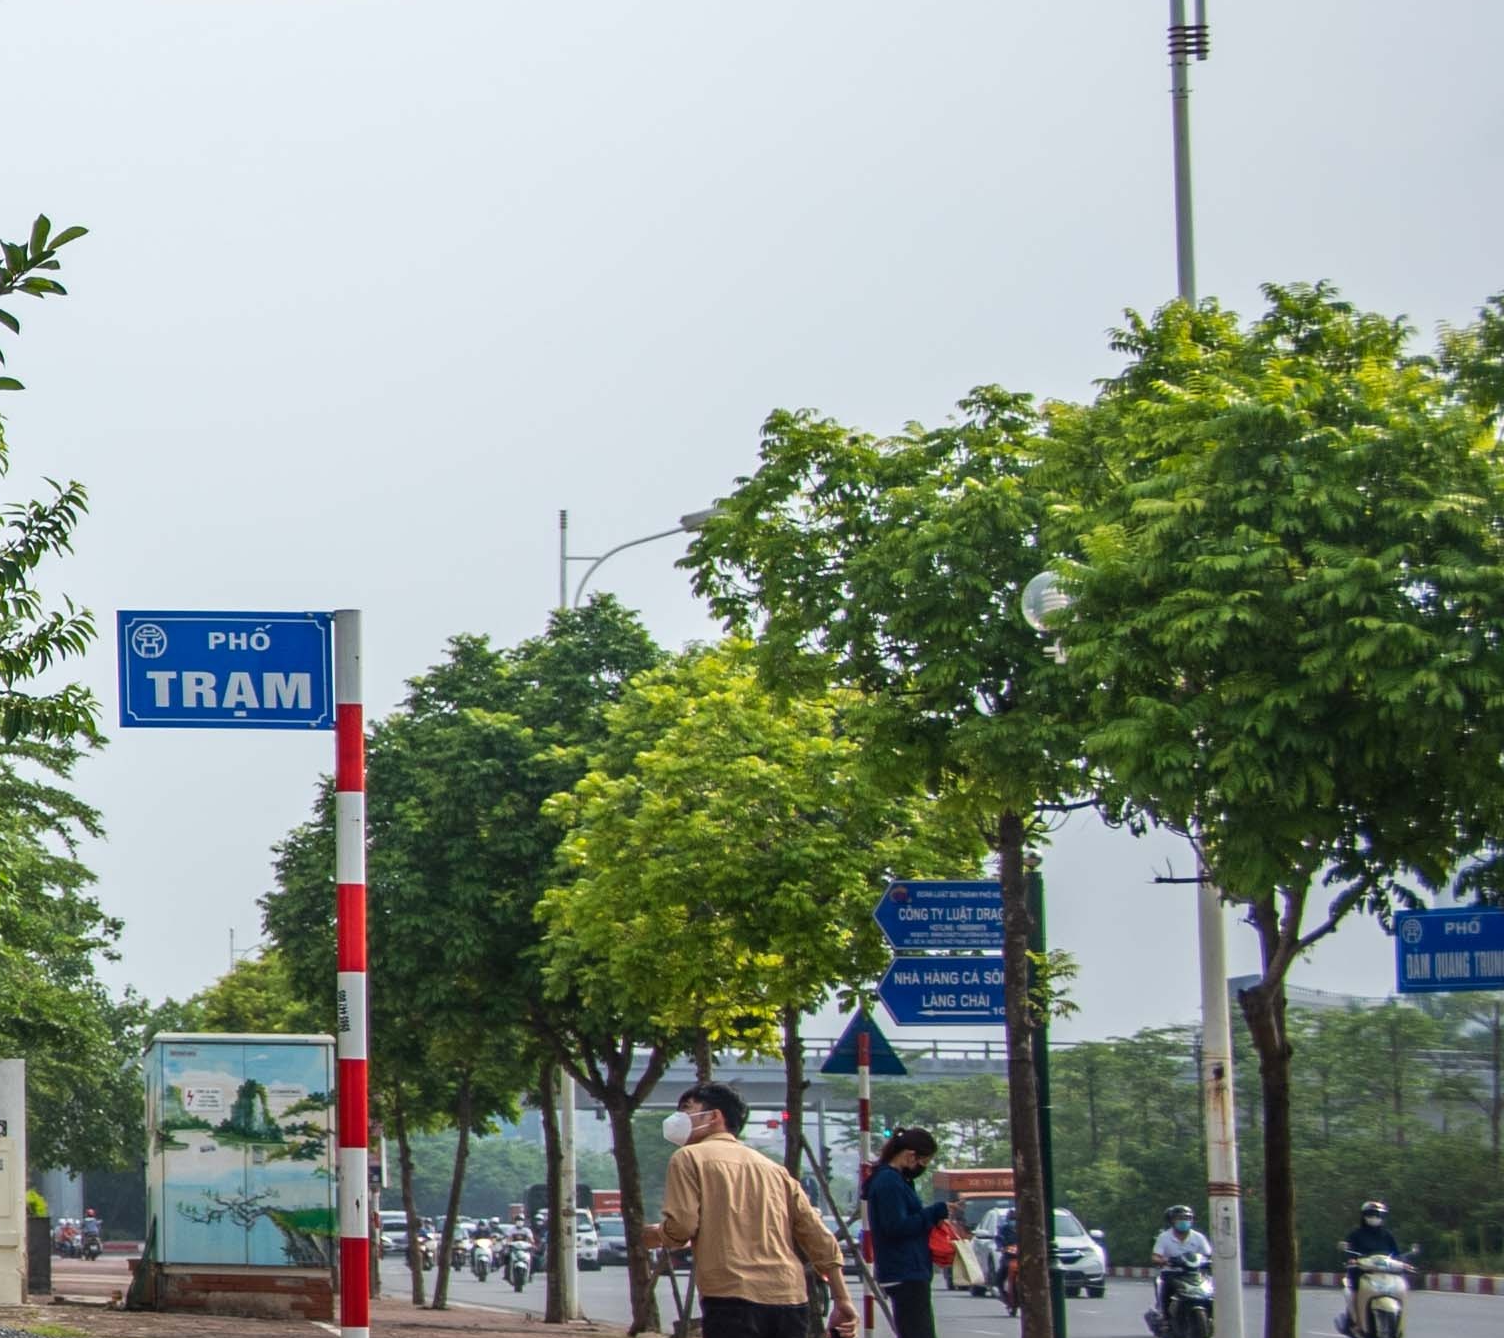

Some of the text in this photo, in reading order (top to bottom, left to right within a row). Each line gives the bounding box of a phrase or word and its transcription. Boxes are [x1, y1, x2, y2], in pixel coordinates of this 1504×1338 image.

[208, 624, 272, 651] PHỐ
[146, 671, 312, 717] TRẠM
[899, 904, 928, 921] CÔNG
[931, 908, 944, 921] TY
[947, 905, 973, 923] LUẬT
[1445, 916, 1482, 935] PHỐ
[894, 969, 920, 985] NHÀ
[924, 968, 959, 985] HÀNG
[962, 969, 980, 985] CÁ
[922, 991, 956, 1007] LÀNG
